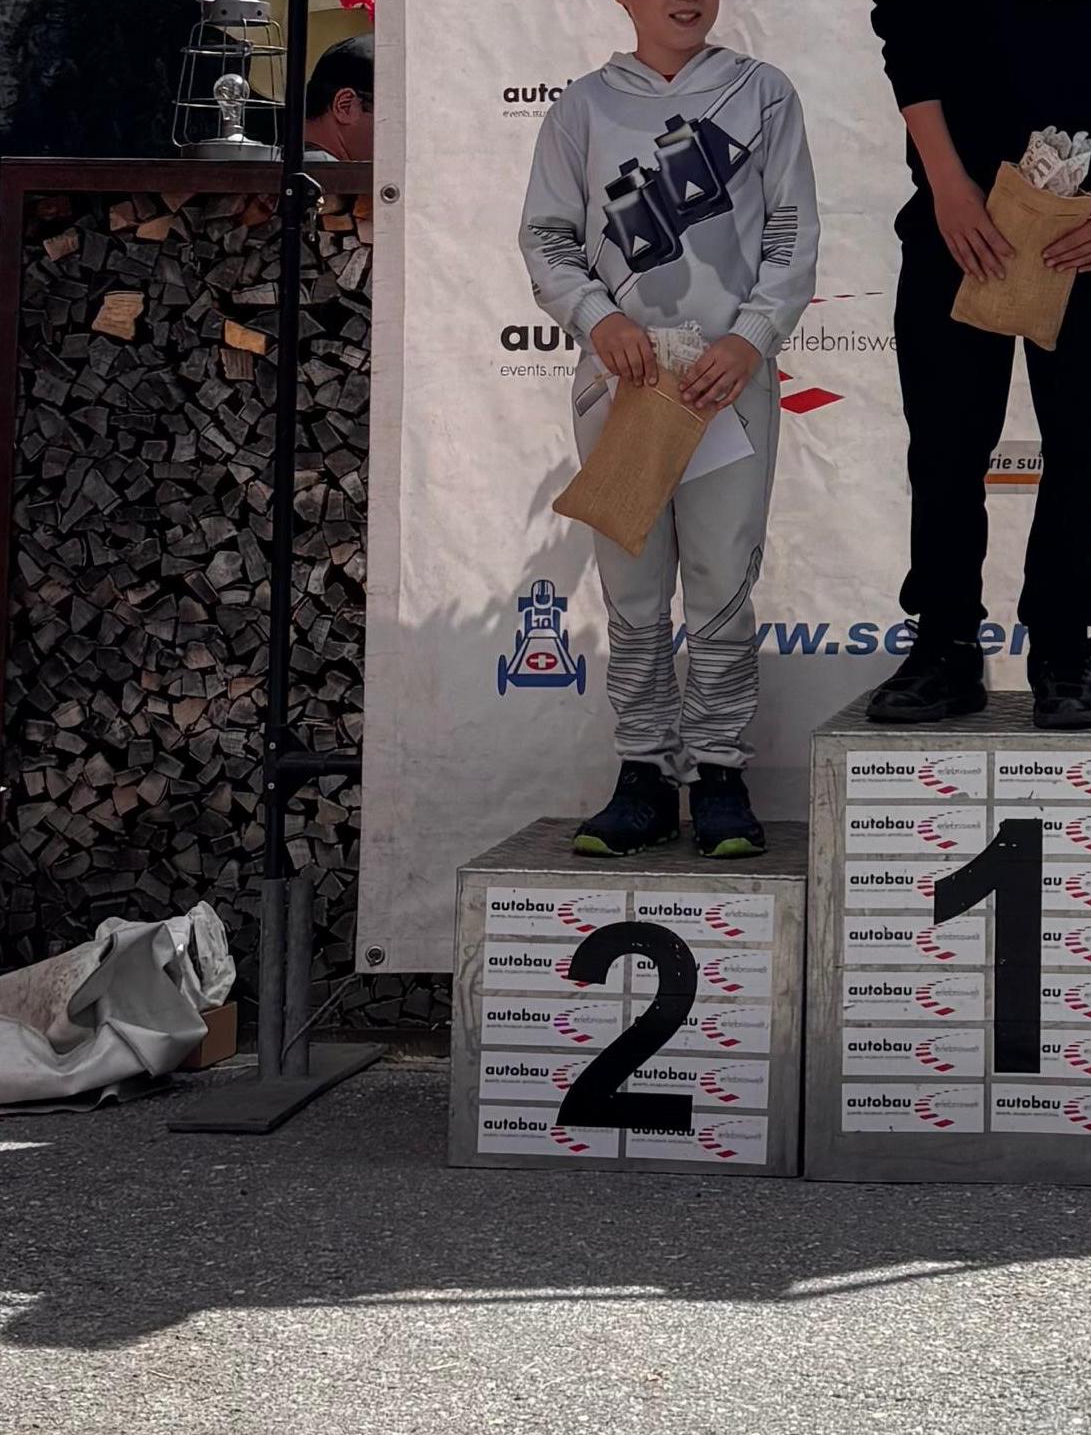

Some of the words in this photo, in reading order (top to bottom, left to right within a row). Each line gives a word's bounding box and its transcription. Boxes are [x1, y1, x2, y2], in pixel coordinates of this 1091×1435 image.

[503, 79, 573, 103] auto
[533, 618, 552, 629] 10
[851, 762, 915, 776] autobau
[999, 763, 1063, 776] autobau
[850, 817, 914, 830] autobau
[850, 872, 914, 885] autobau
[491, 899, 555, 912] autobau
[638, 904, 703, 917] autobau
[849, 928, 913, 941] autobau
[934, 818, 1043, 1074] 1
[489, 954, 552, 968] autobau
[848, 983, 912, 996] autobau
[487, 1009, 551, 1022] autobau
[555, 920, 698, 1130] 2
[847, 1039, 912, 1052] autobau
[485, 1064, 549, 1078] autobau
[634, 1068, 697, 1081] autobau
[847, 1095, 911, 1108] autobau
[996, 1095, 1061, 1110] autobau
[483, 1117, 547, 1132] autobau
